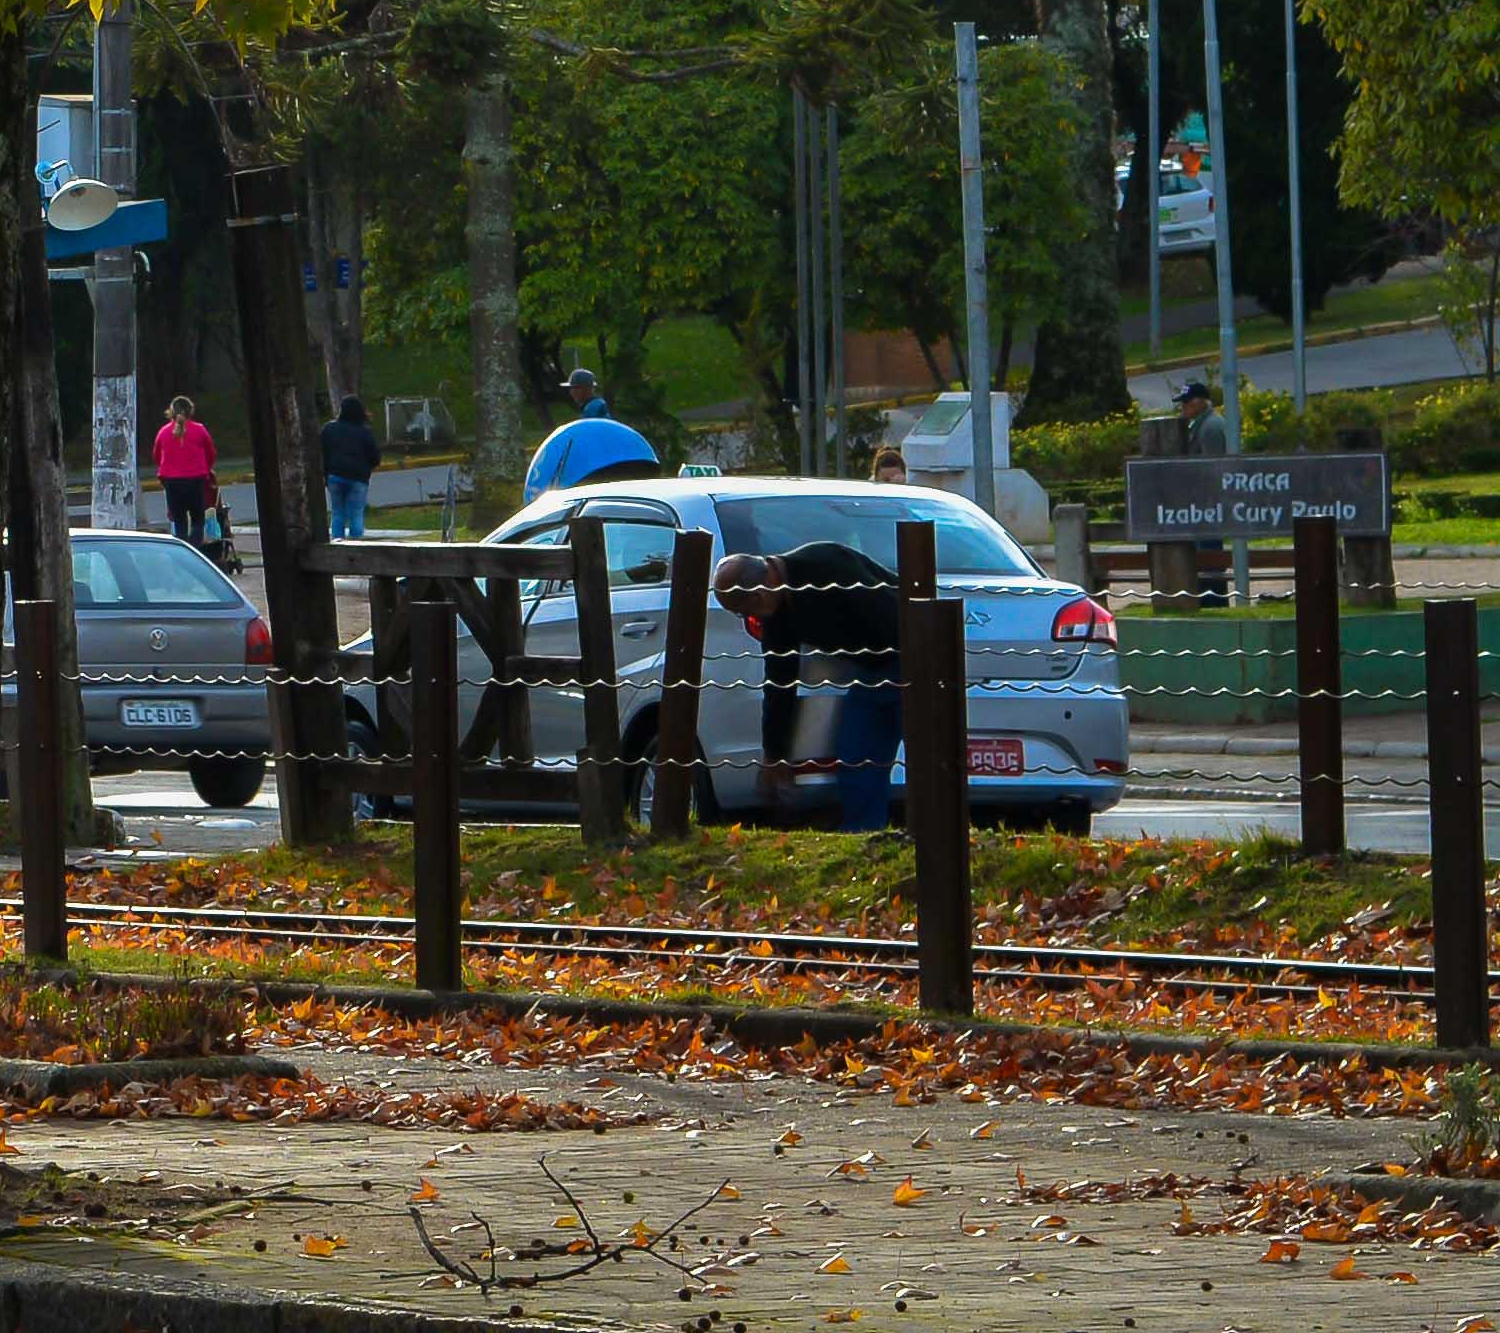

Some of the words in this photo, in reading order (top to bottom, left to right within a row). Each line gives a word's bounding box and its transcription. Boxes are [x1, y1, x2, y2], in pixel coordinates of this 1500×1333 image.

[1222, 472, 1290, 494] PRAÇA
[1157, 502, 1223, 525] Izabel
[1232, 502, 1283, 526] Cury
